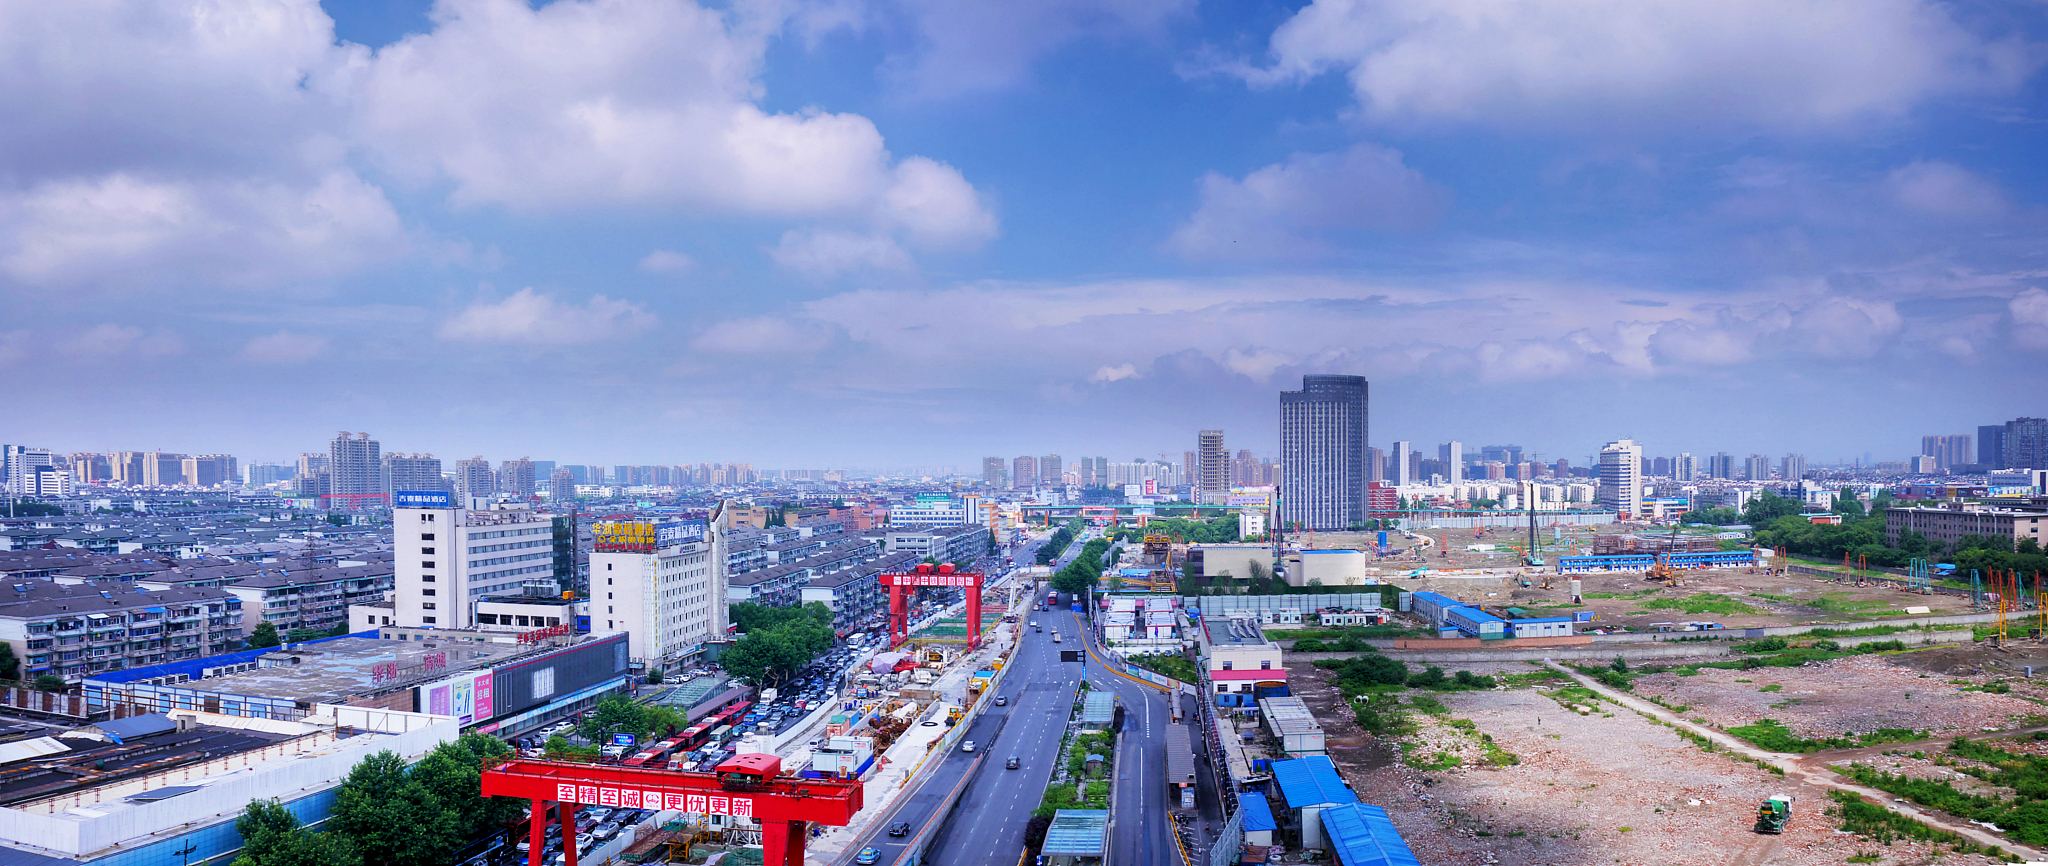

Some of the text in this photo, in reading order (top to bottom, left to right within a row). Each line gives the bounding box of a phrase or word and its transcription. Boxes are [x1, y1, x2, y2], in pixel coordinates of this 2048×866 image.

[592, 523, 654, 535] 华浙数码通讯
[660, 524, 701, 541] 吉泰精品酒店
[373, 652, 446, 682] 华浙 商城
[477, 688, 490, 700] 招租
[559, 785, 751, 816] 至精至诚 更优更新
